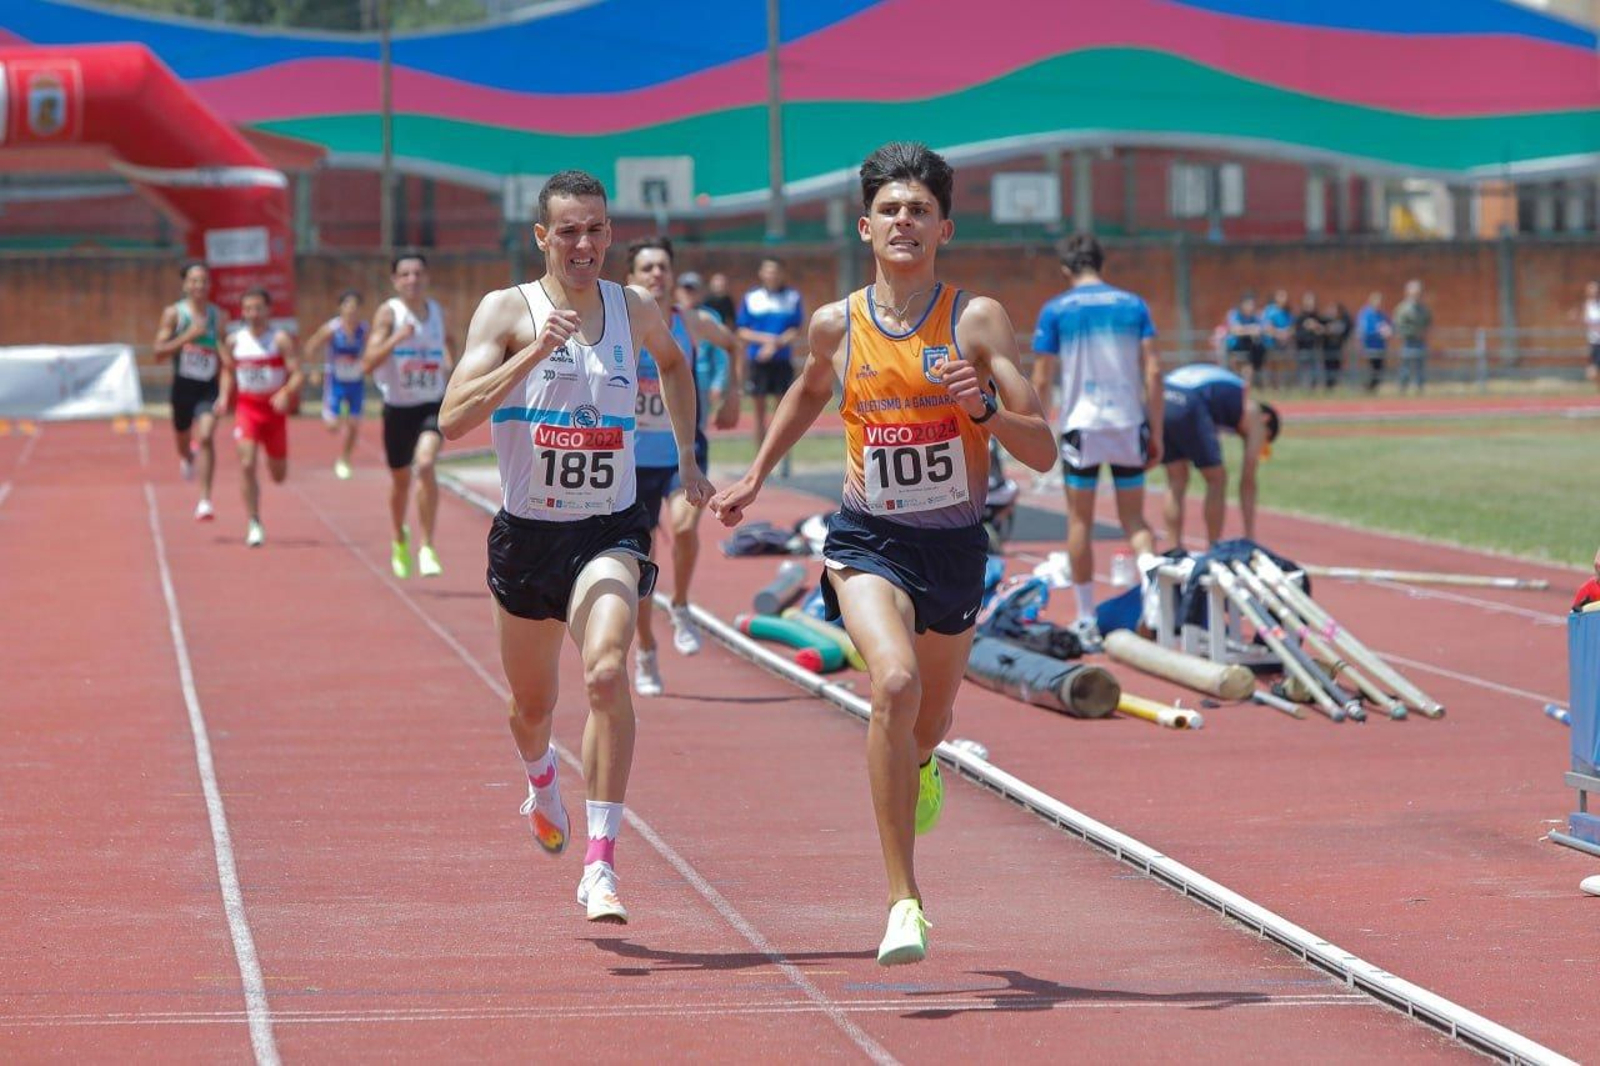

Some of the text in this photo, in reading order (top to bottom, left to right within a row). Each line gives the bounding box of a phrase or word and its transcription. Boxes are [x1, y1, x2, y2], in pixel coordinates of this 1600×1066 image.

[856, 397, 902, 413] ATLETISMO
[904, 397, 911, 409] A
[539, 428, 622, 448] VIGO 2024
[866, 416, 958, 444] VIGO 2024
[540, 449, 614, 489] 185
[872, 442, 953, 488] 105
